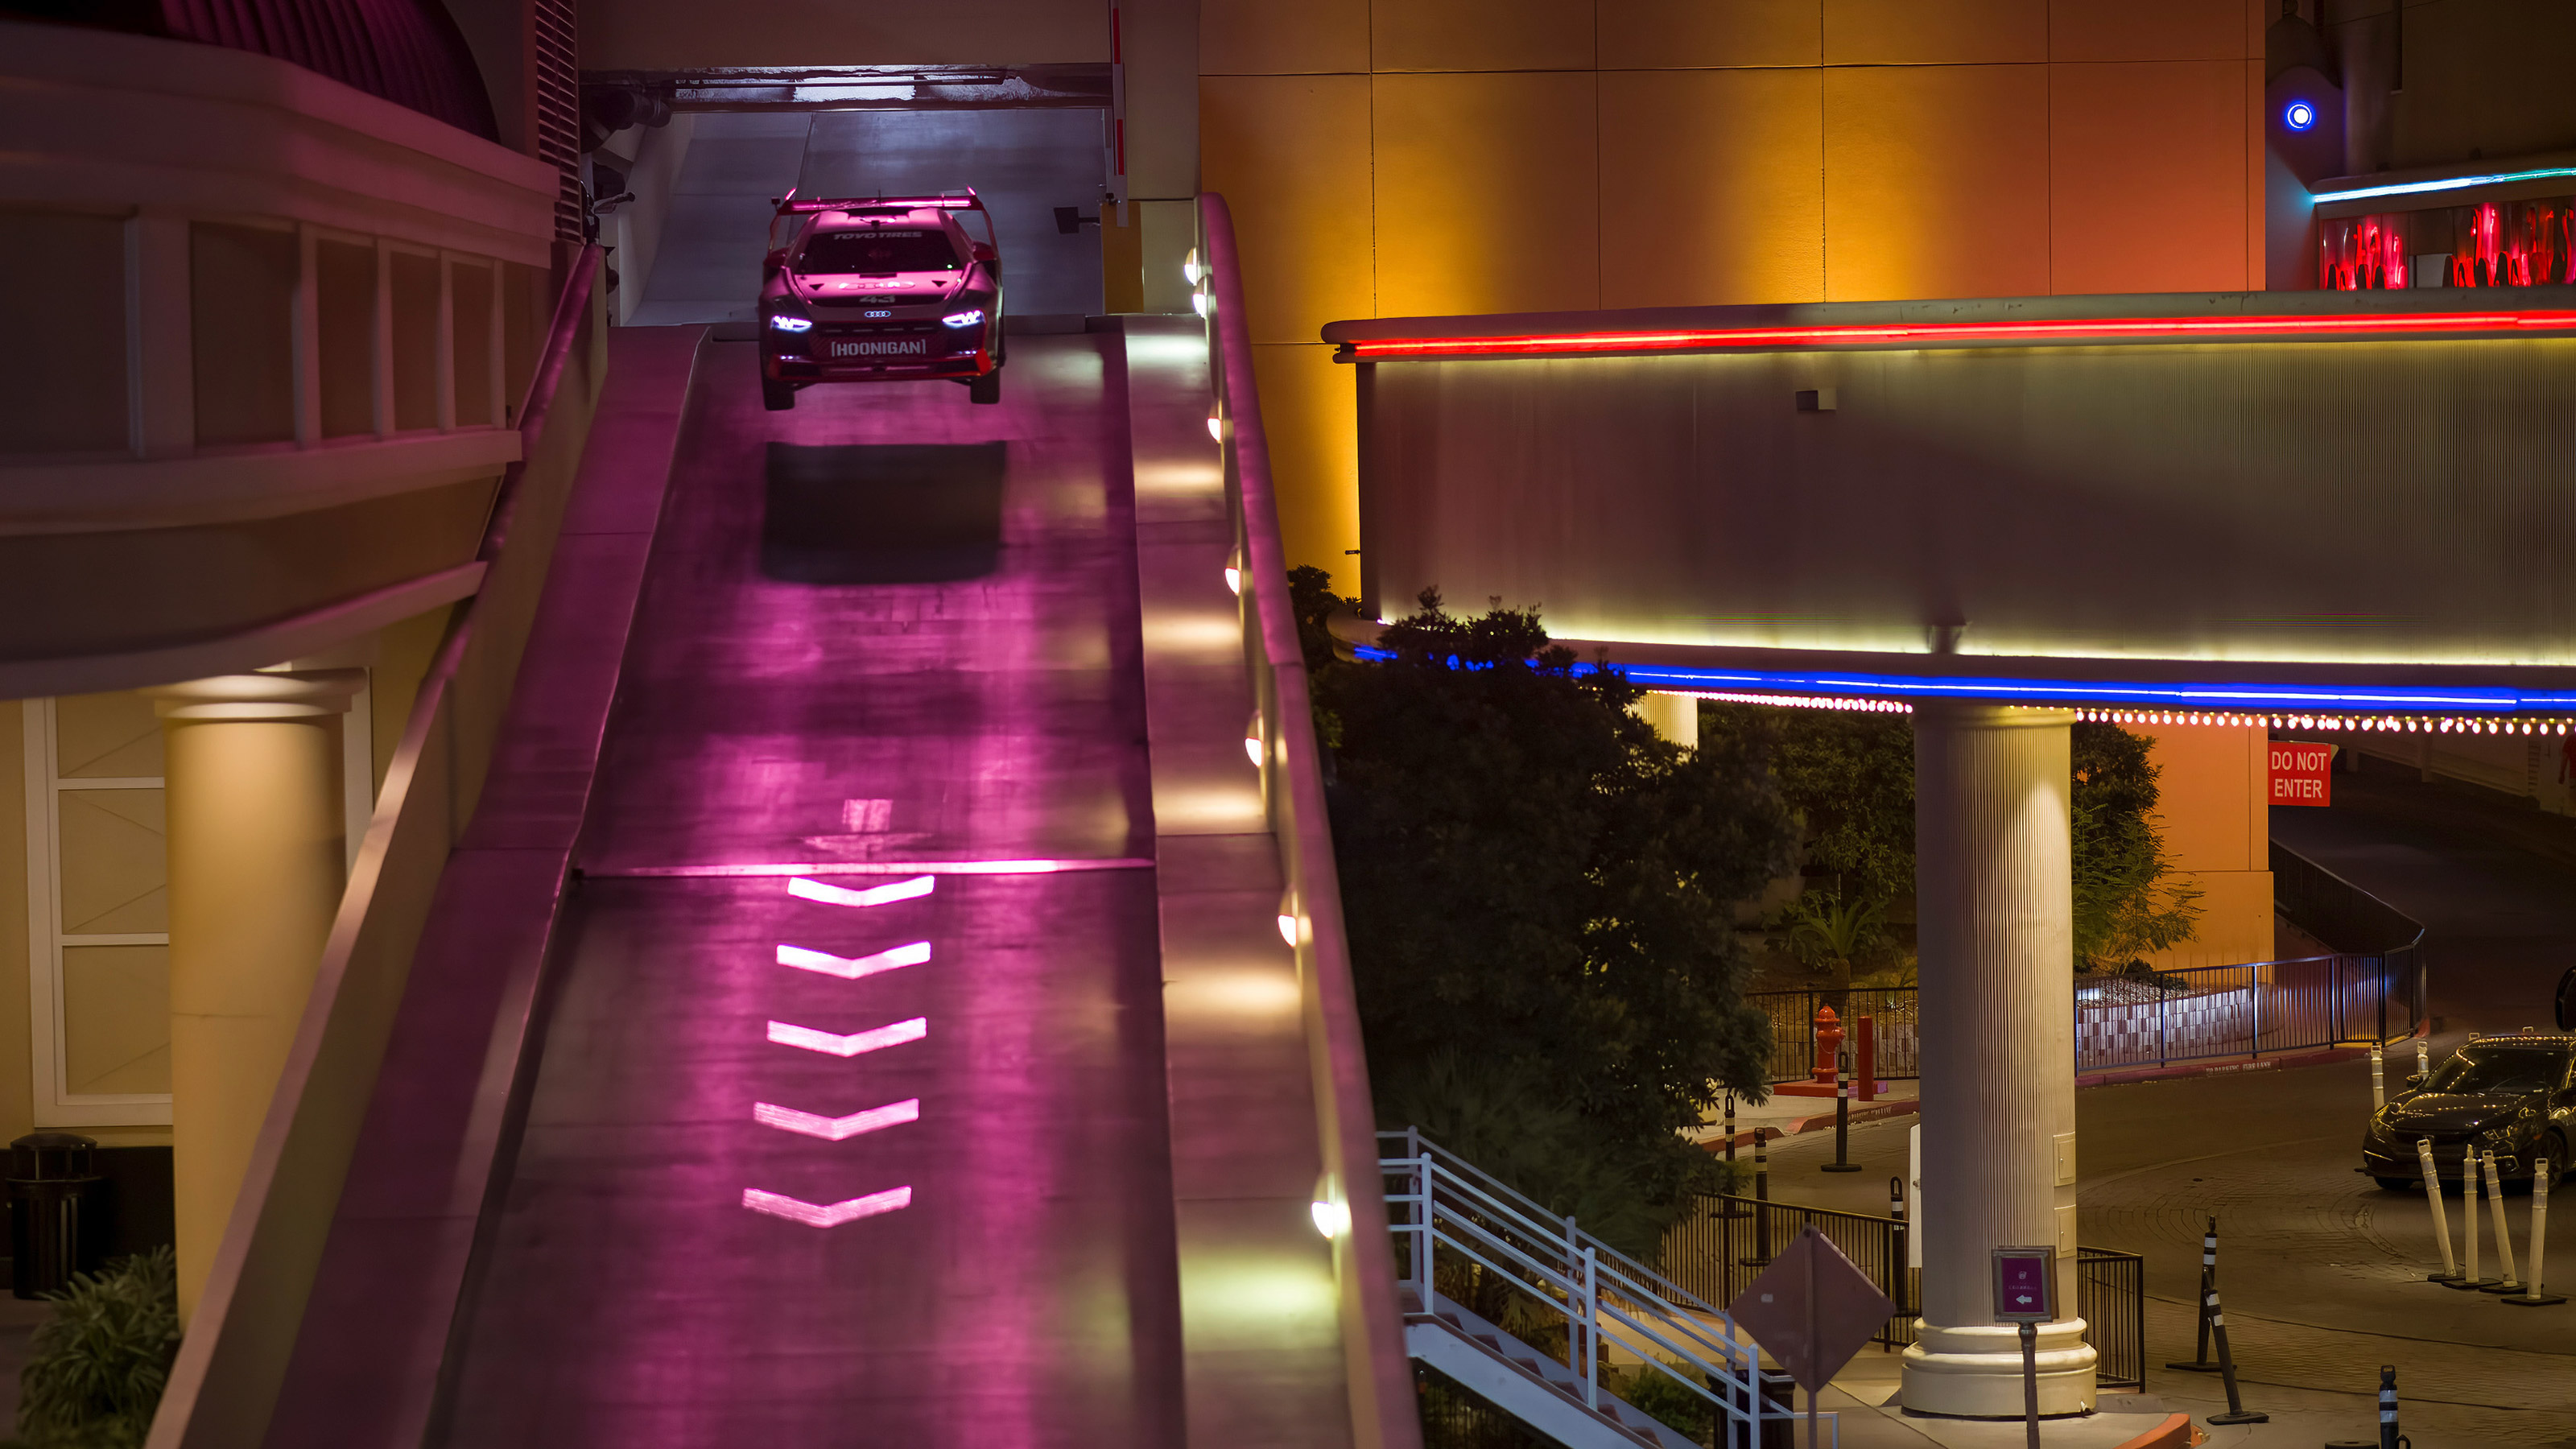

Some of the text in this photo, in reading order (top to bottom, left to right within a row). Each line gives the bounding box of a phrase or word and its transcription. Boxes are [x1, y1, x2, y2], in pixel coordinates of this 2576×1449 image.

[859, 294, 896, 303] 43
[2272, 751, 2327, 771] DO NOT
[2274, 778, 2322, 799] ENTER
